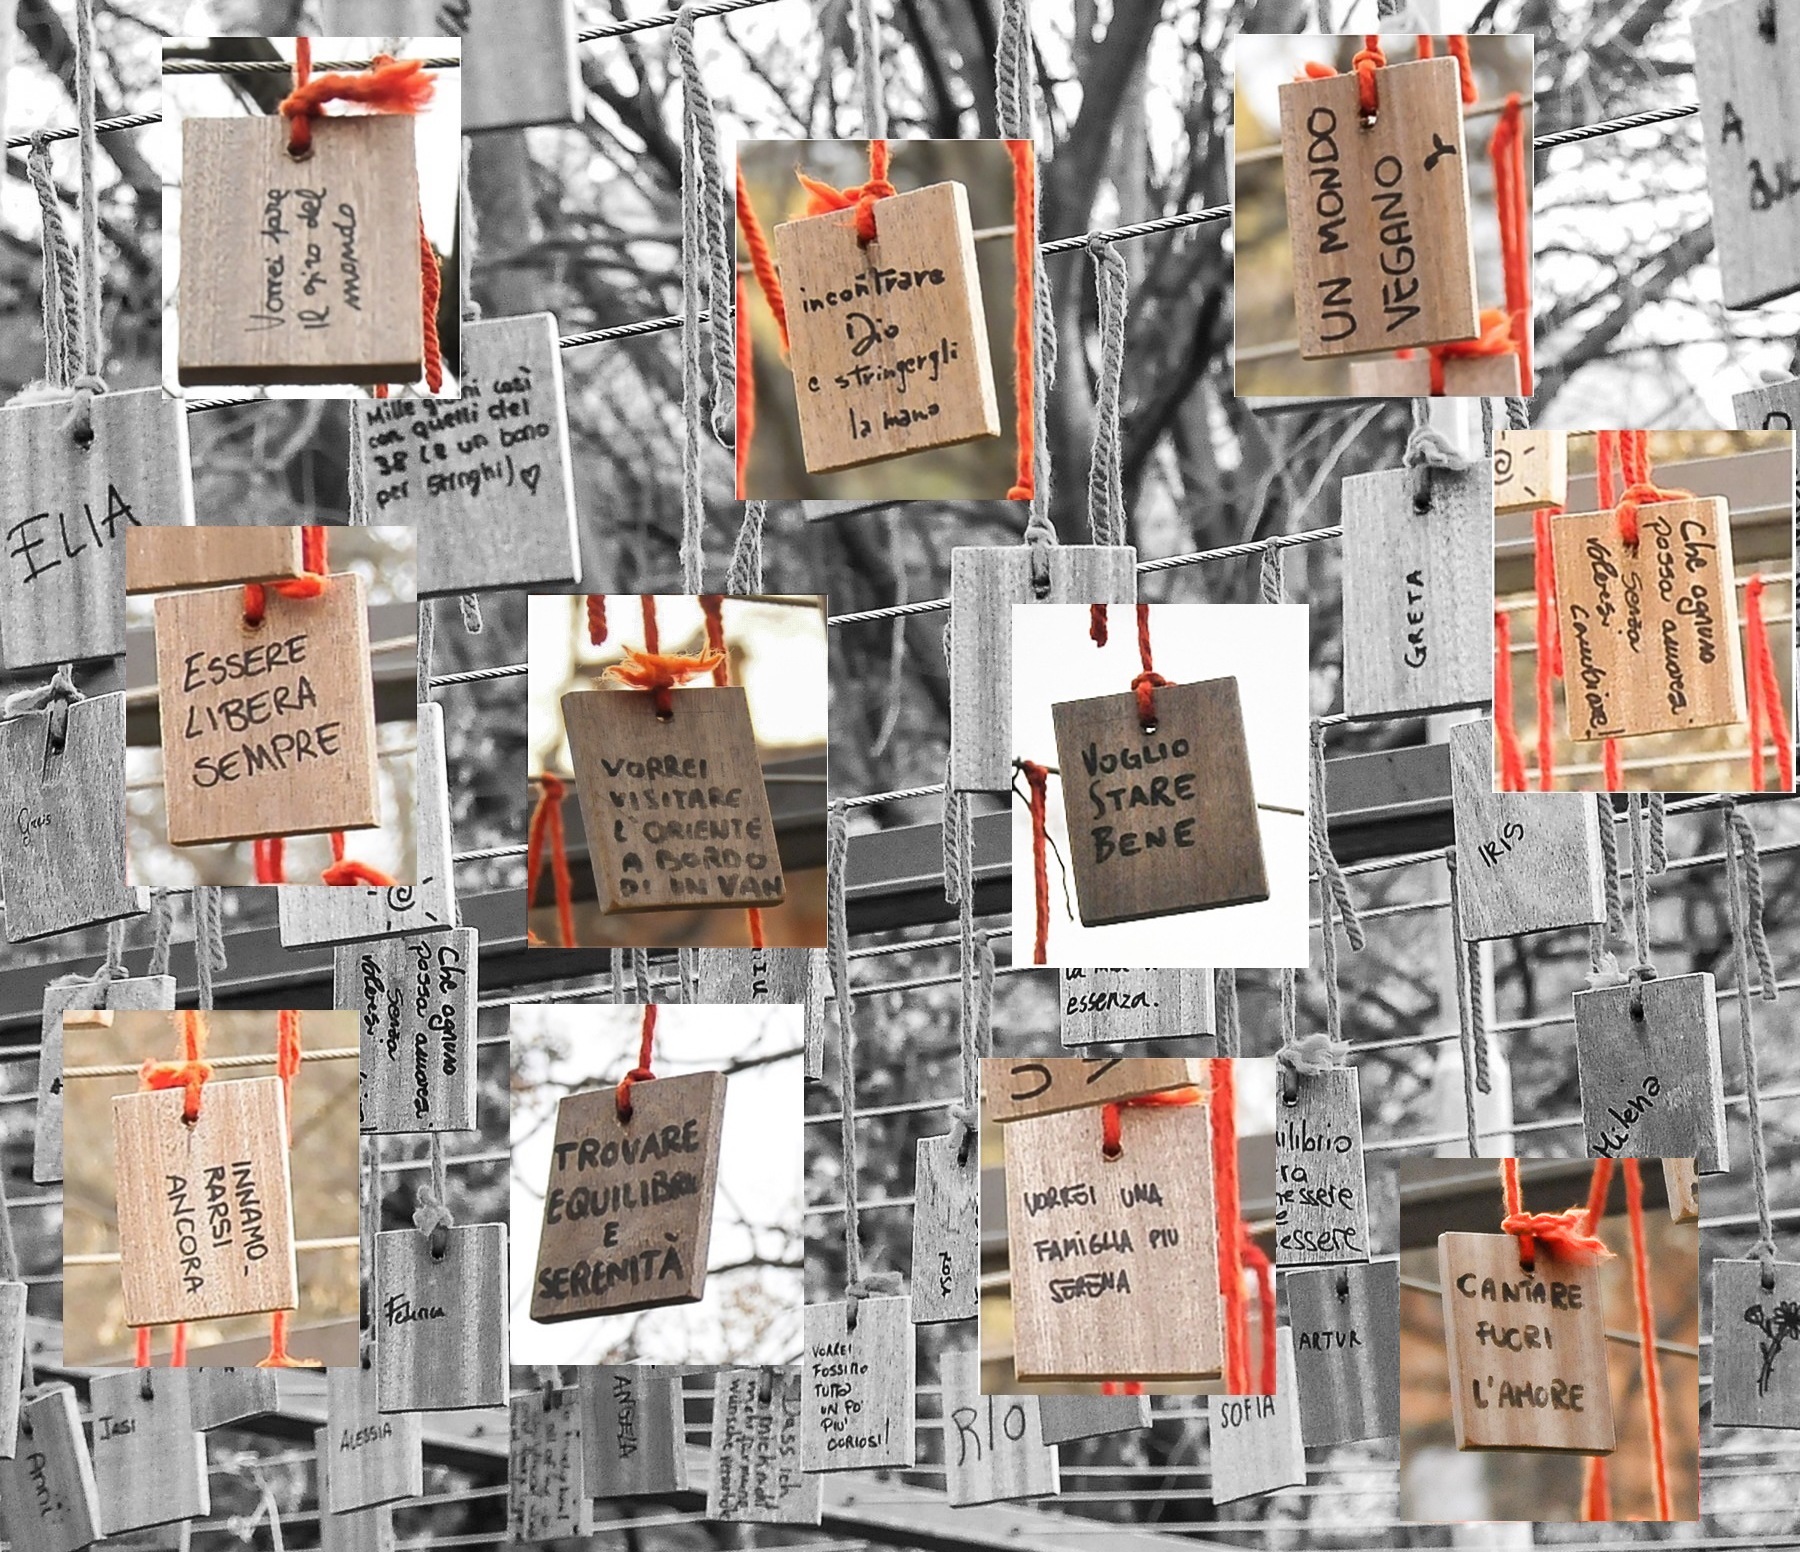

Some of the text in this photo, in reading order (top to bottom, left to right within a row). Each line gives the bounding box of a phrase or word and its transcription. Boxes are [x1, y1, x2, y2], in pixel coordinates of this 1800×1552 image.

[294, 187, 328, 229] del
[1307, 107, 1357, 342] UN MONDO
[331, 203, 362, 312] mondo
[1371, 155, 1421, 332] VEGANO
[301, 243, 328, 295] giro
[800, 266, 946, 313] incontrare
[244, 254, 286, 333] Vorrei
[846, 312, 900, 357] Dio
[808, 337, 958, 394] e stringergli
[412, 402, 479, 440] quelli
[487, 398, 530, 421] del
[850, 403, 940, 440] la mano
[456, 433, 489, 455] un
[376, 480, 409, 510] per
[7, 485, 141, 584] ELIA
[1643, 516, 1677, 602] possa
[1676, 520, 1716, 665] Che ognuno
[1404, 567, 1429, 669] GRETA
[184, 634, 308, 693] ESSERE
[185, 675, 317, 739] LIBERA
[192, 721, 341, 788] SEMPRE
[601, 754, 708, 780] VORREI
[1081, 738, 1190, 777] VOGLIO
[609, 786, 743, 811] VISITARE
[1089, 773, 1197, 820] STARE
[622, 846, 768, 873] A BORDO
[1091, 816, 1196, 864] BENE
[1478, 822, 1524, 868] IRIS
[717, 873, 783, 898] VAN
[408, 940, 433, 1019] possa
[428, 945, 466, 1076] Che ognuno
[1066, 991, 1160, 1016] essenza.
[1592, 1075, 1661, 1158] Milena
[553, 1118, 700, 1172] TROVARE
[203, 1166, 233, 1248] RARSI
[1024, 1182, 1164, 1217] VORREI UNA
[165, 1174, 205, 1294] ANCORA
[602, 1221, 620, 1248] E
[1149, 1227, 1179, 1250] PIU
[537, 1232, 685, 1300] SERENITÀ
[1050, 1269, 1131, 1303] SERENA
[1456, 1272, 1583, 1311] CANTARE
[812, 1341, 852, 1358] VORREI
[1300, 1330, 1362, 1351] ARTUR
[1475, 1320, 1553, 1353] FUORI
[812, 1362, 869, 1378] FOSSIMO
[1221, 1395, 1275, 1428] SOFIA
[1472, 1375, 1585, 1413] L'AMORE
[339, 1422, 393, 1452] ALESSIA
[951, 1394, 1026, 1467] RIO
